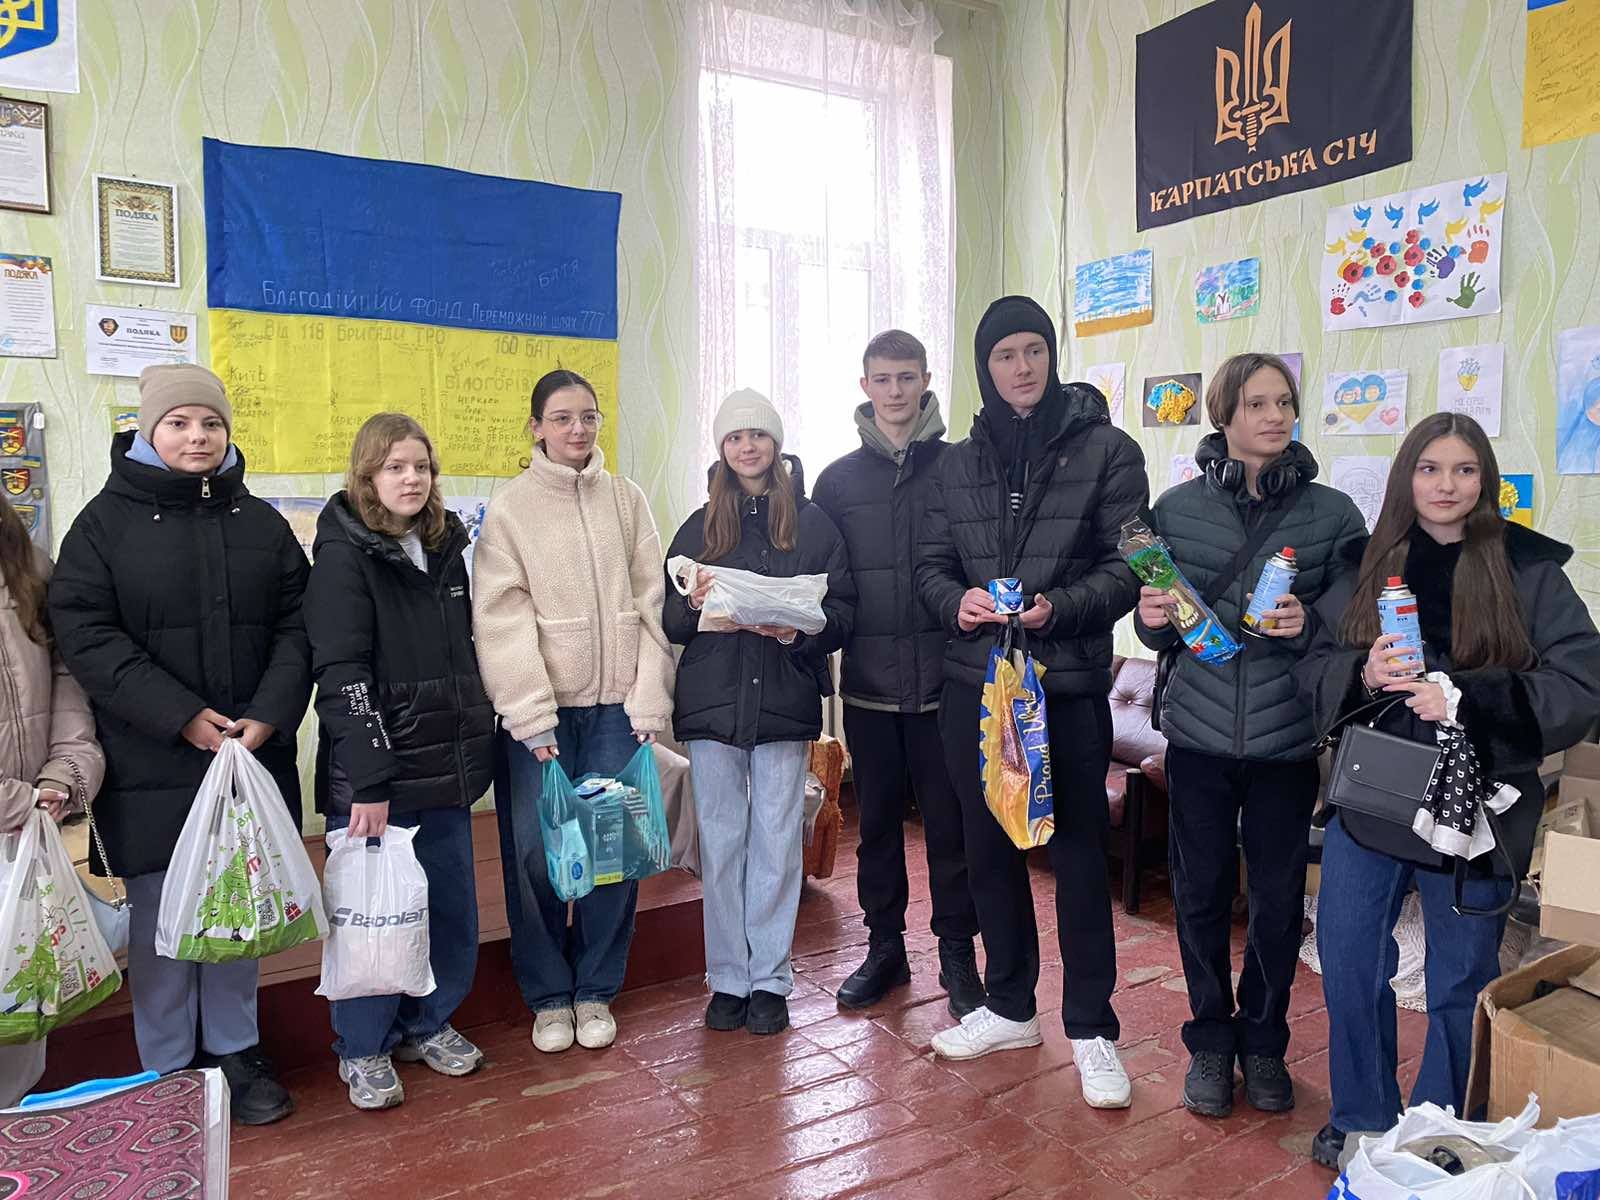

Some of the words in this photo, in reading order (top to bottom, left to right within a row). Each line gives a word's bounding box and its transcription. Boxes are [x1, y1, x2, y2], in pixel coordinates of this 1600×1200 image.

[1150, 148, 1317, 213] КАРПАТСЬКА
[1323, 129, 1378, 166] СІЧ
[115, 208, 159, 221] ПОДЯКА
[4, 268, 38, 280] ПОДЯКА
[1028, 743, 1053, 805] Proud
